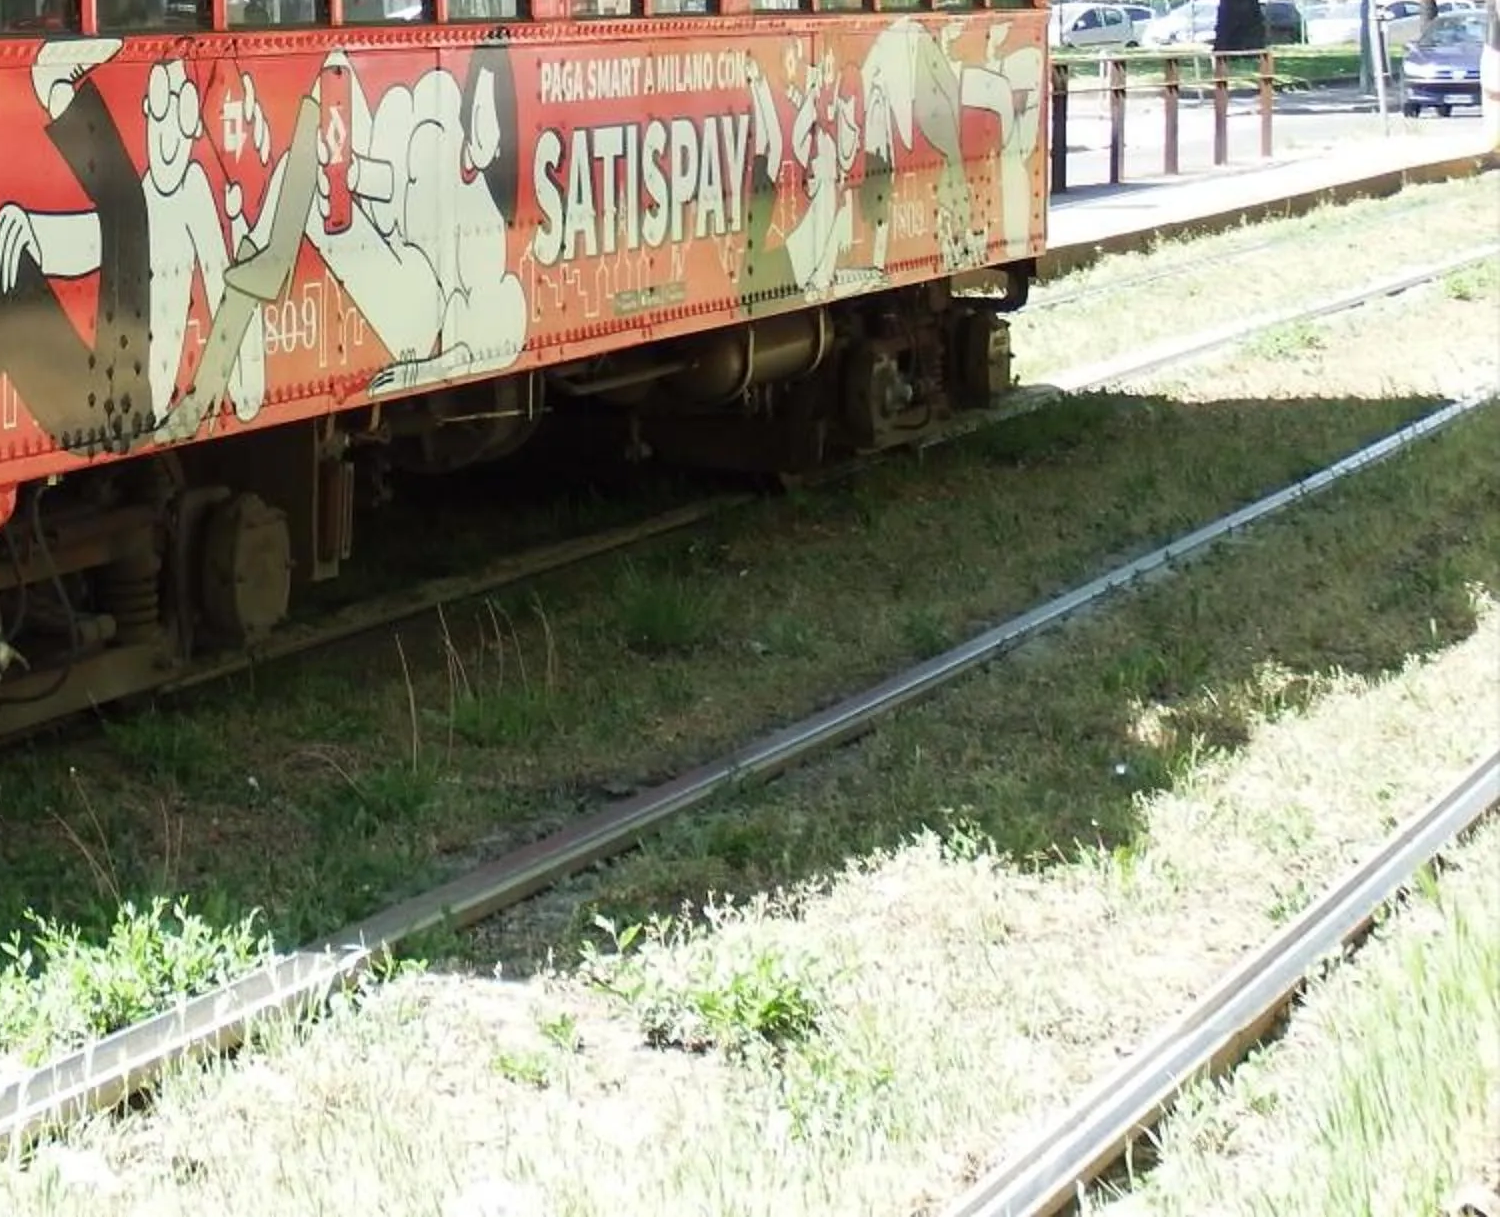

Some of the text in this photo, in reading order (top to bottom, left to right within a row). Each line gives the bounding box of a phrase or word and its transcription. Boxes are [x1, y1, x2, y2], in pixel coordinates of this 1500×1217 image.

[541, 49, 746, 103] PAGA SMART A MILANO CON
[534, 114, 750, 266] SATISPAY
